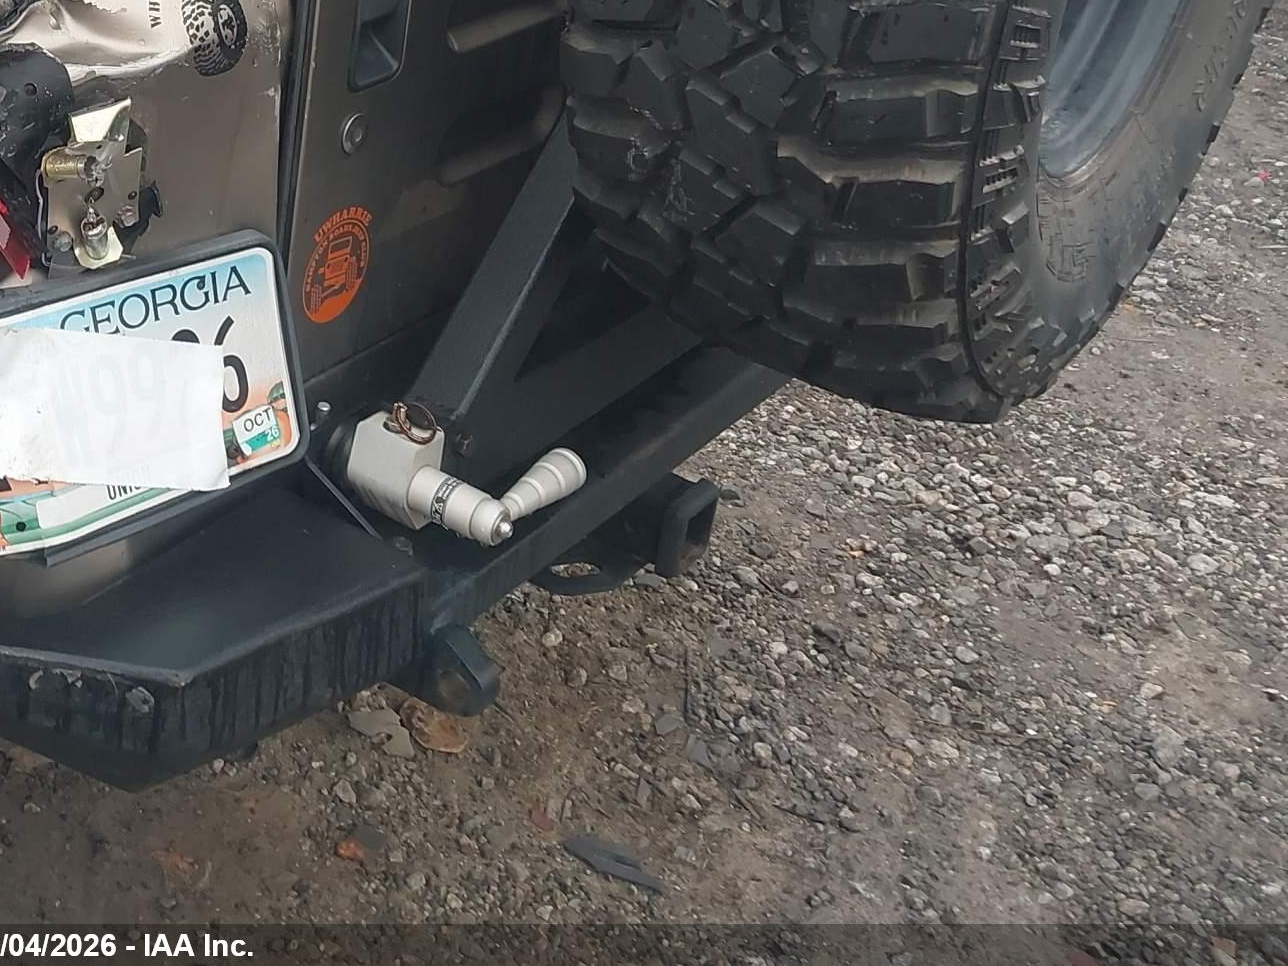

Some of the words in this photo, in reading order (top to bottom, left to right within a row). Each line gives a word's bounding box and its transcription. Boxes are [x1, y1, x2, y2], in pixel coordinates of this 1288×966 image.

[314, 206, 372, 243] UWHARRIE
[59, 265, 252, 335] GEORGIA
[243, 407, 272, 432] OCT
[266, 425, 280, 442] 26
